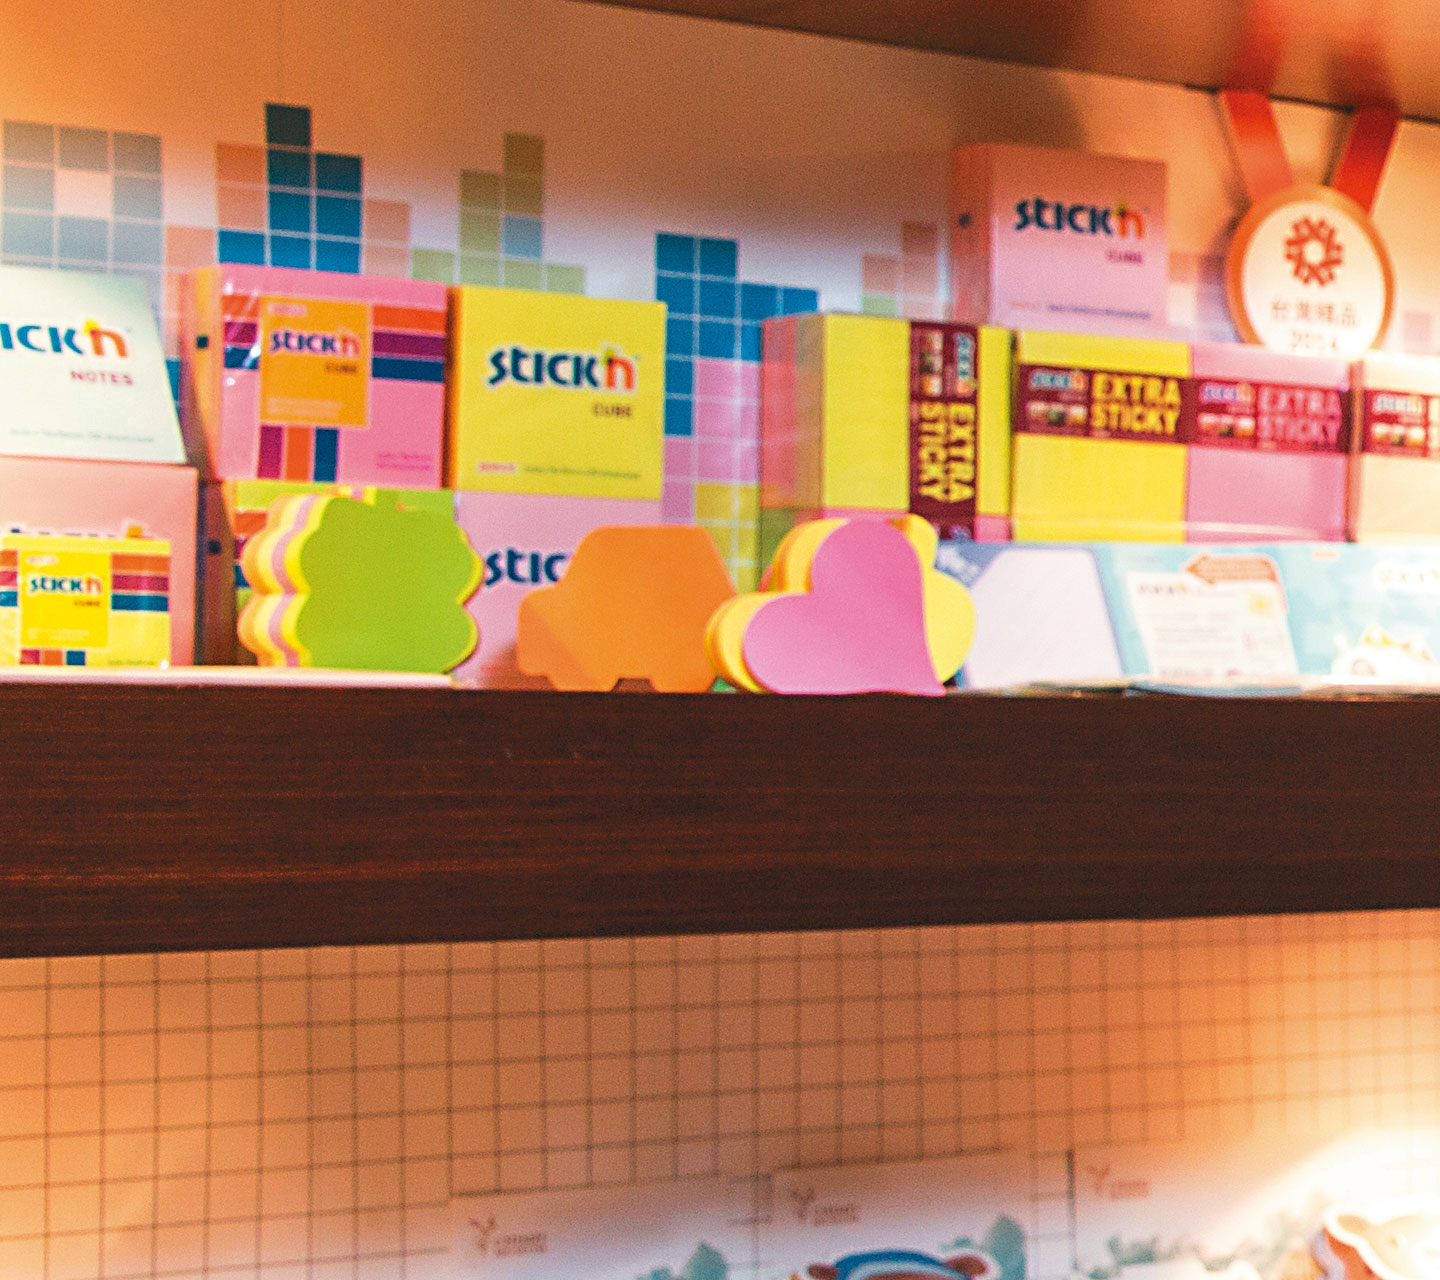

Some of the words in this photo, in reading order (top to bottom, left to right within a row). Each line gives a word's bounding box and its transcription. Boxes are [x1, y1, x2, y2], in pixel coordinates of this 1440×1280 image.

[70, 369, 135, 387] NOTES
[1091, 371, 1182, 407] EXTRA
[1090, 401, 1181, 436] STICKY
[1257, 385, 1343, 421] EXTRA
[1257, 415, 1342, 451] STICKY
[918, 402, 948, 504] STICKY
[947, 402, 977, 504] EXTRA
